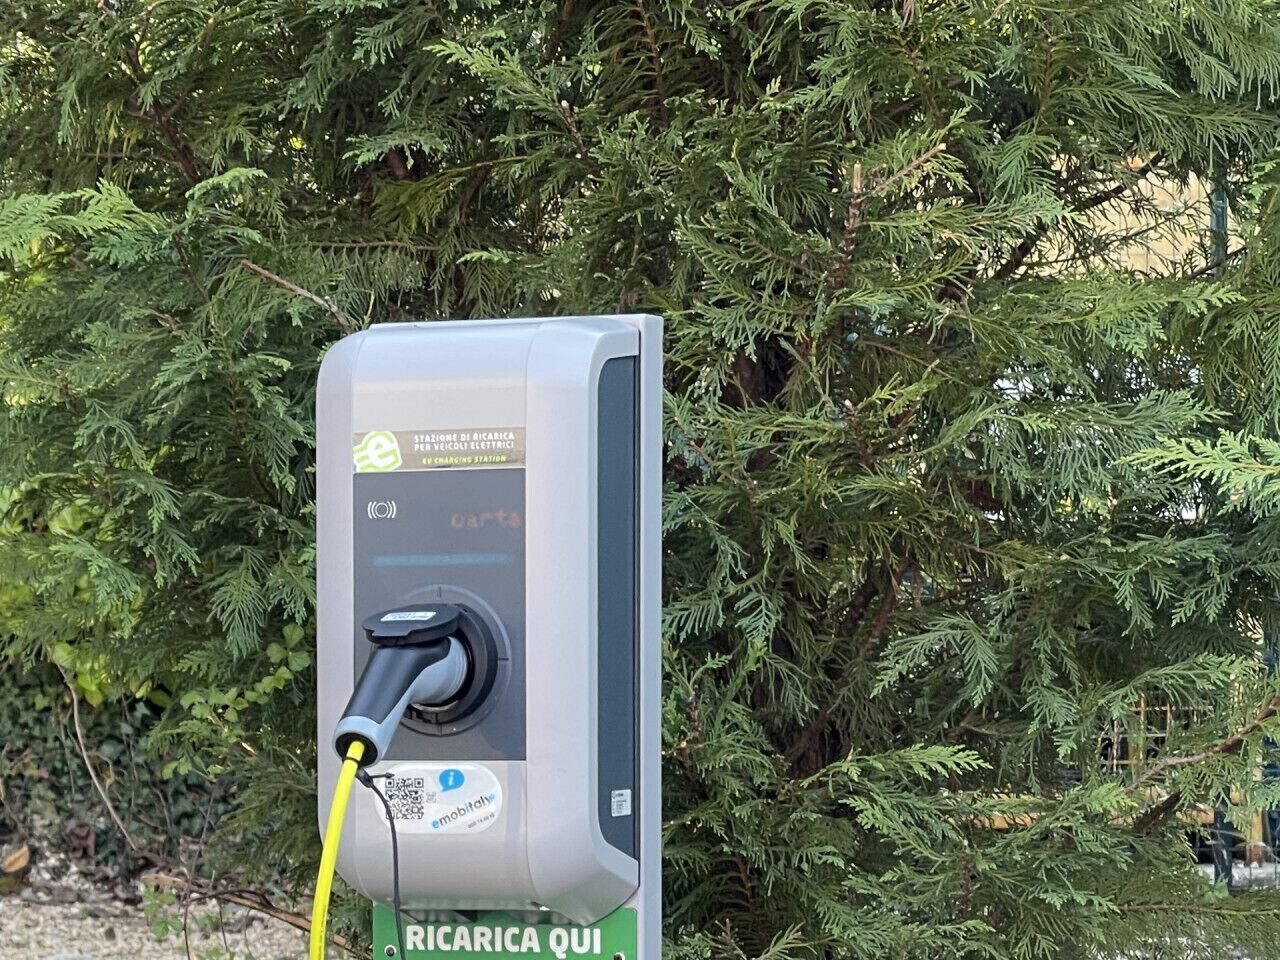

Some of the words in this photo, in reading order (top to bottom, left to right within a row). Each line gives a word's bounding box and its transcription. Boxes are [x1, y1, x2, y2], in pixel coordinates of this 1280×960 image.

[414, 433, 458, 443] STAZIONE
[461, 433, 470, 442] DI
[473, 431, 515, 441] RICARICA
[414, 443, 431, 451] PER
[434, 442, 468, 451] VEICOLI
[470, 441, 514, 449] ELETTRICI
[474, 455, 507, 463] STATION
[405, 925, 541, 953] RICARICA
[548, 927, 601, 959] QUI
